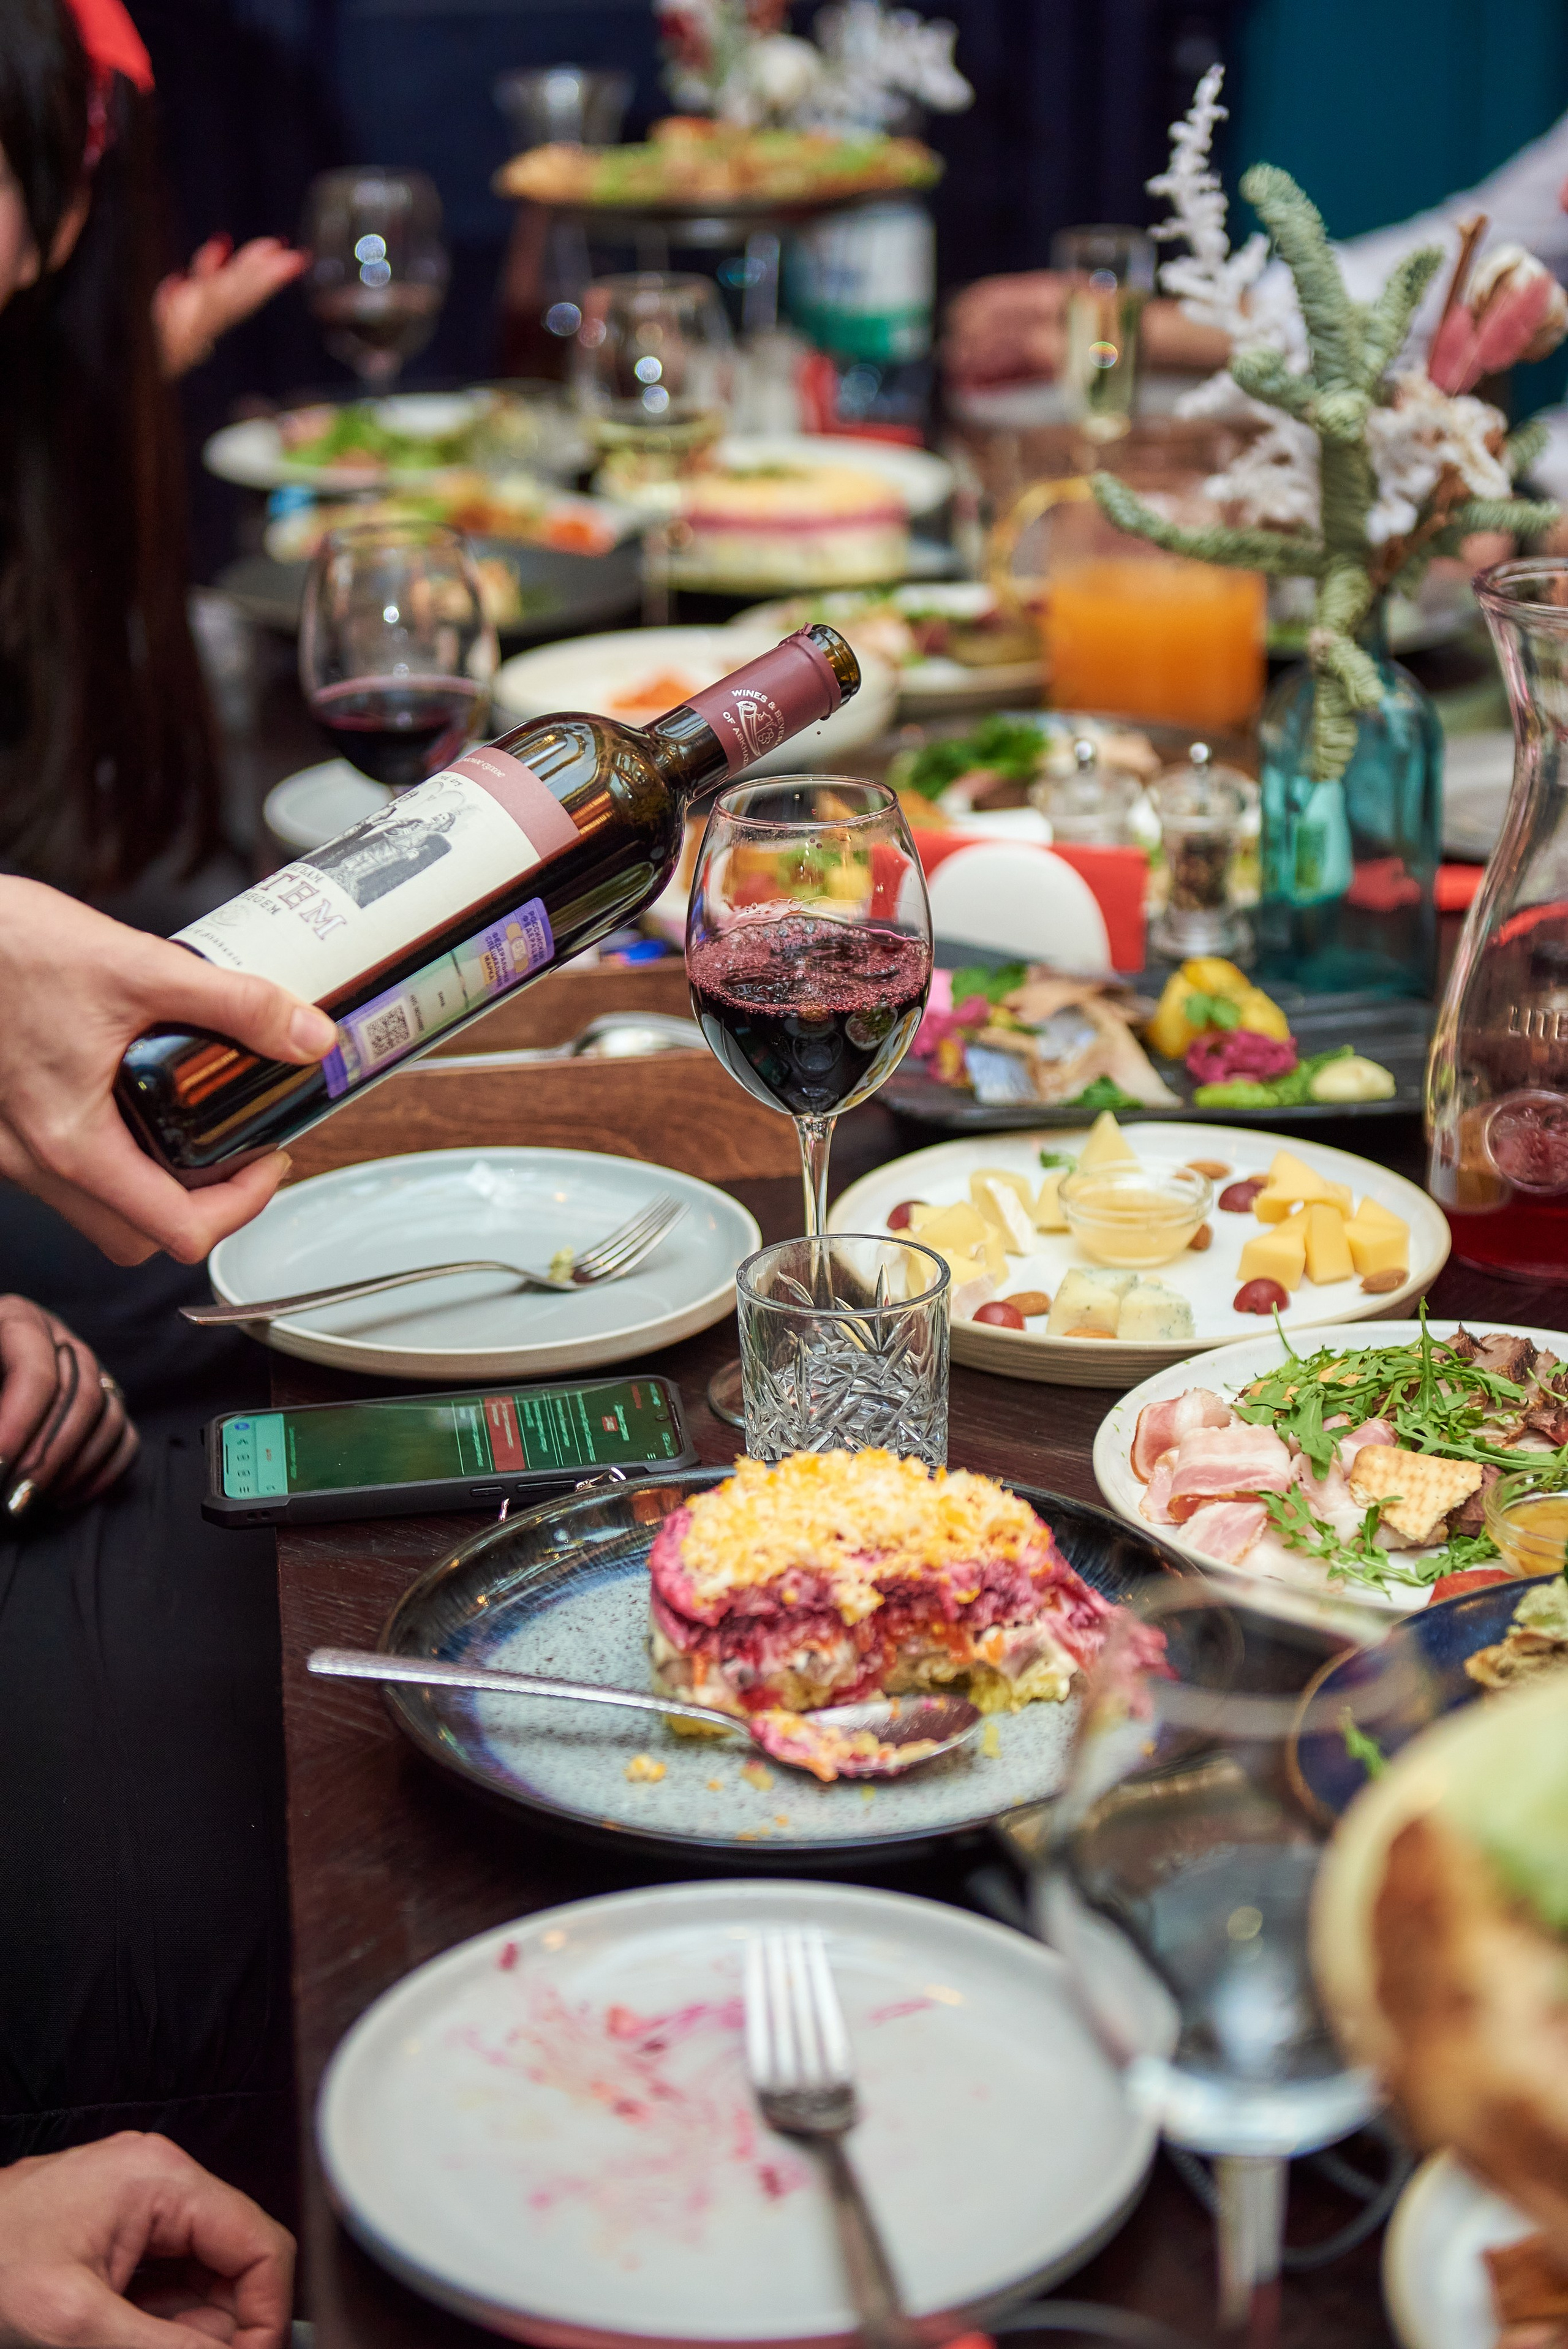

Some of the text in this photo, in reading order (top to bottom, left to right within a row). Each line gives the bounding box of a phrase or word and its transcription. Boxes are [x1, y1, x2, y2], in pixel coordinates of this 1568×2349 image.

[731, 689, 768, 703] WINES
[768, 701, 775, 711] &
[723, 711, 736, 725] OF
[238, 891, 281, 915] HEGEM
[251, 872, 347, 940] ГЕМ
[484, 954, 494, 980] МАРКА
